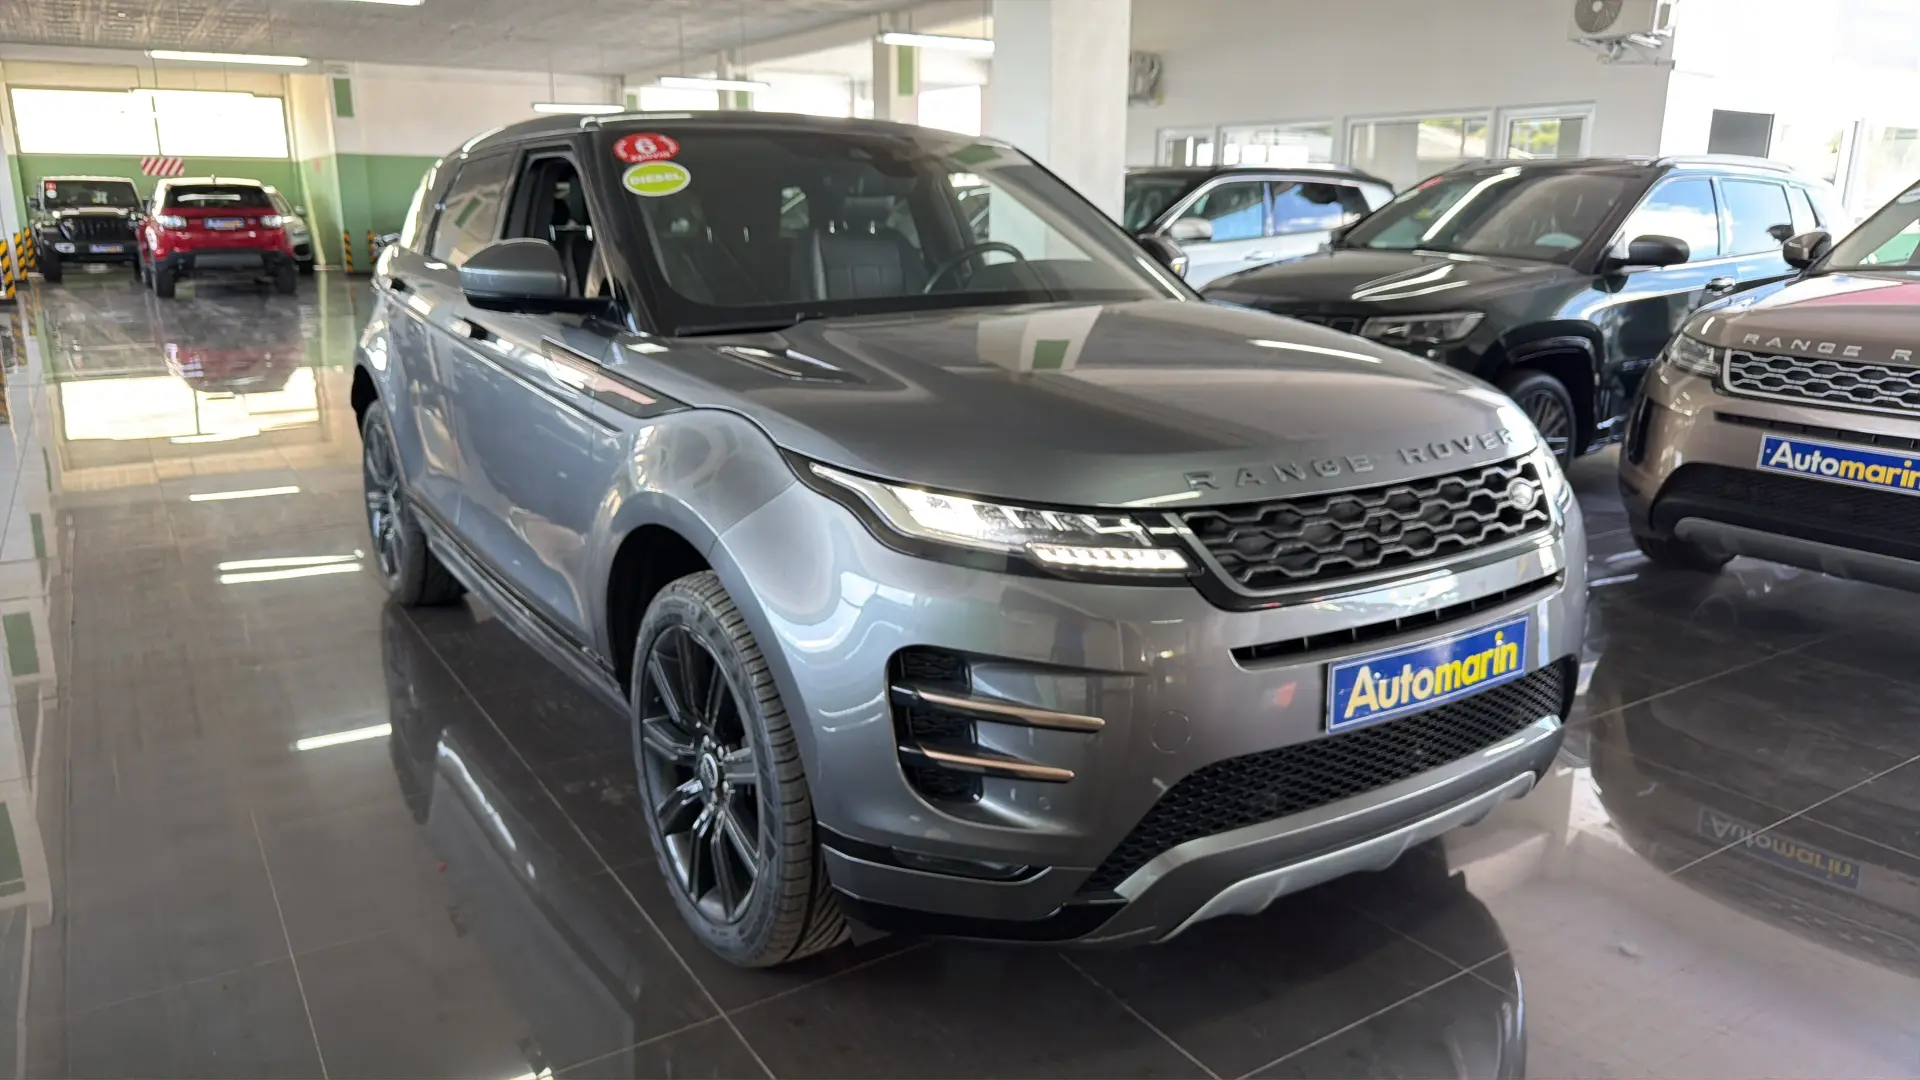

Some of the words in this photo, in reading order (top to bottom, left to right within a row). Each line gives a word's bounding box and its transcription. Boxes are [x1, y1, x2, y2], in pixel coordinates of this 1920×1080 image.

[634, 138, 658, 154] 6
[630, 171, 683, 185] DIESEL
[1743, 332, 1863, 358] RANGE
[1184, 454, 1375, 490] RANGE
[1398, 427, 1517, 465] ROVER
[1768, 440, 1920, 490] Automarin
[1343, 630, 1519, 719] Automarin
